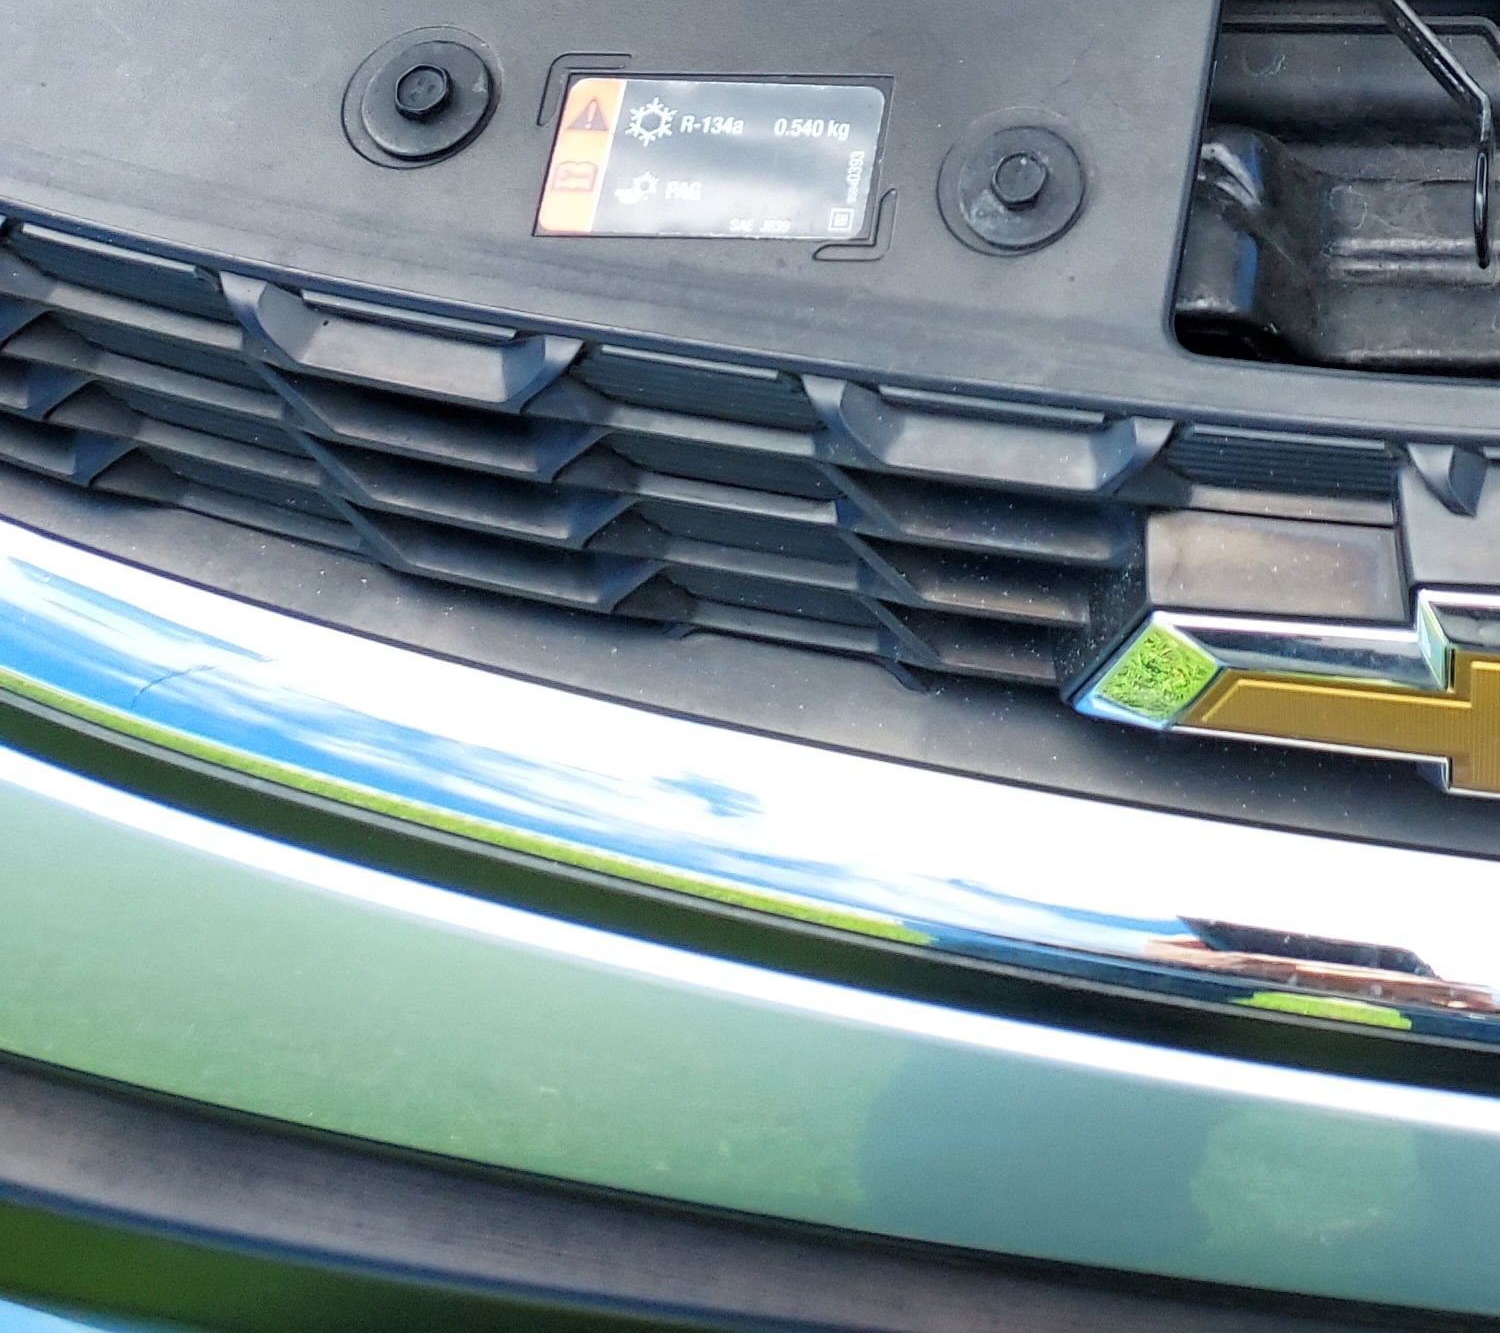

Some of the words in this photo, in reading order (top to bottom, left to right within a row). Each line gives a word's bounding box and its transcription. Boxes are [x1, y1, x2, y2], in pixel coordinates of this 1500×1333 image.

[680, 115, 743, 134] R-134a
[774, 118, 823, 136] 0.540
[827, 120, 850, 140] kg
[665, 181, 700, 200] PAG
[730, 219, 753, 232] SAE
